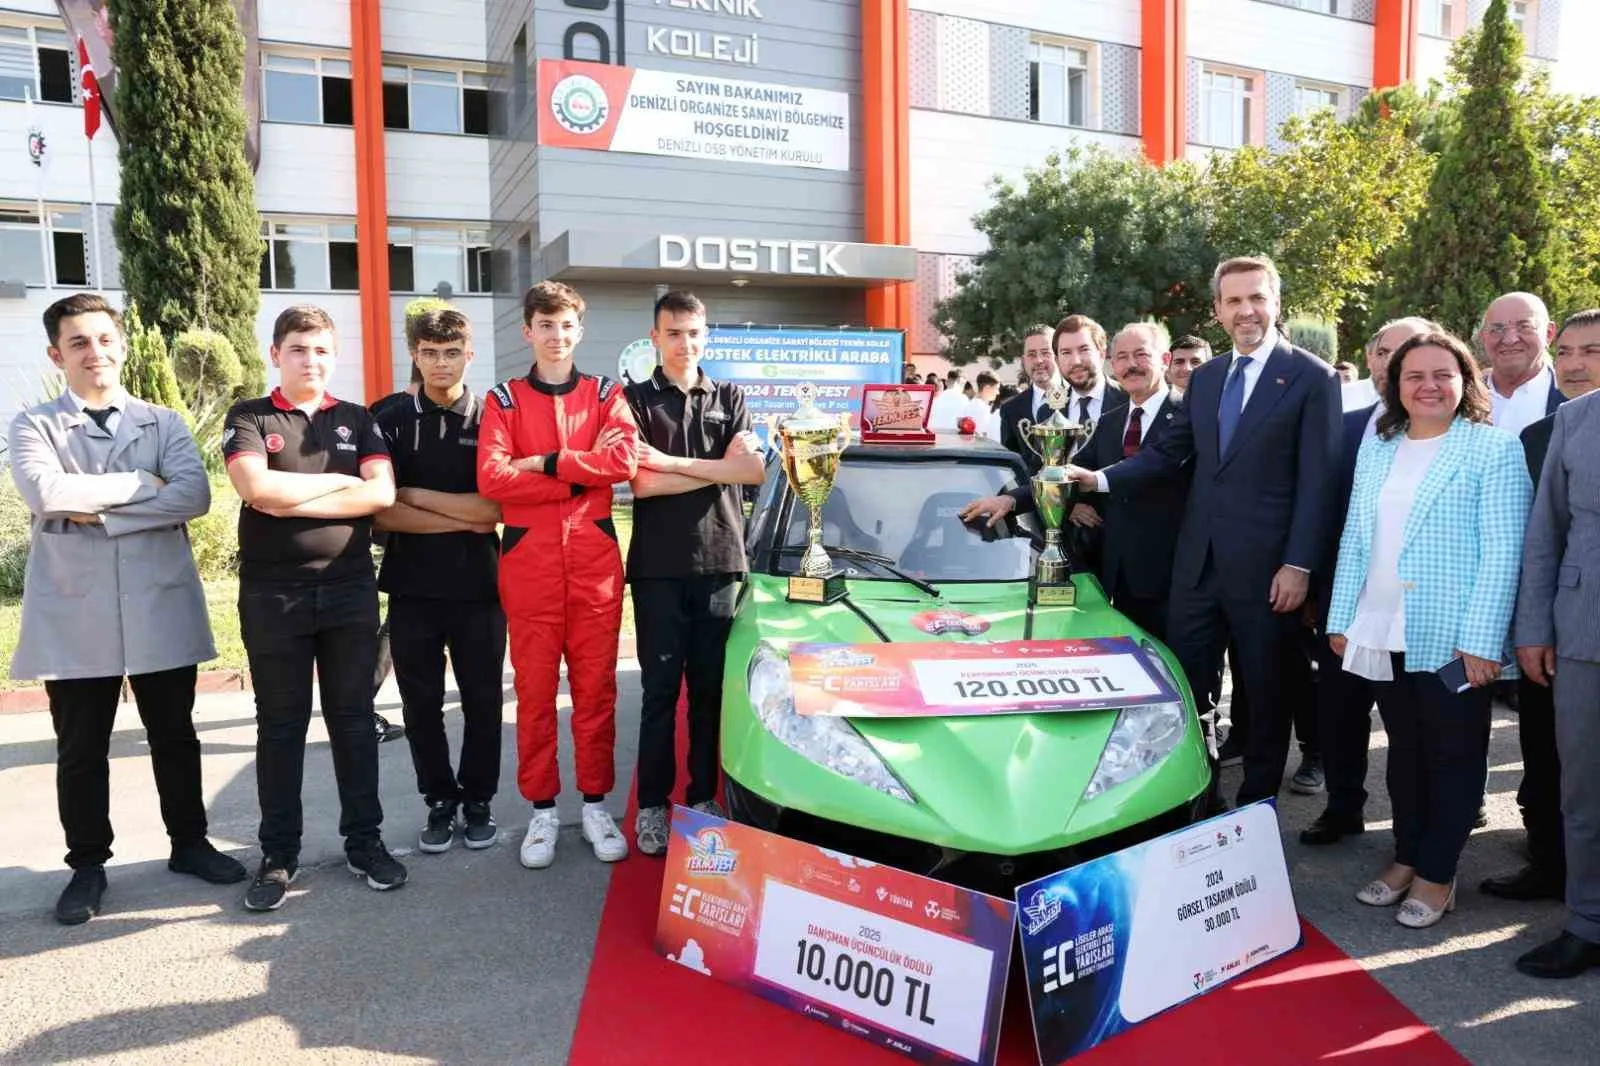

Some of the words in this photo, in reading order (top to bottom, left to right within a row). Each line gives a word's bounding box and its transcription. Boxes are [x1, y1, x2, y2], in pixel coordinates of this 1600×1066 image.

[647, 26, 759, 64] KOLEJİ
[676, 79, 720, 97] SAYIN
[724, 84, 803, 106] BAKANIMIZ
[630, 94, 677, 112] DENİZLİ
[679, 99, 739, 118] ORGANİZE
[741, 104, 782, 123] SANAYİ
[784, 108, 844, 130] BÖLGEMİZE
[694, 120, 790, 142] HOŞGELDİNİZ
[657, 136, 701, 153] DENİZLİ
[704, 141, 728, 155] OSB
[730, 143, 778, 161] YÖNETİM
[781, 149, 823, 164] KURULU
[658, 234, 849, 276] DOSTEK
[756, 346, 837, 363] ELEKTRİKLİ
[840, 350, 890, 364] ARABA
[954, 677, 1081, 698] 120.000
[1084, 675, 1124, 693] TL
[1205, 869, 1224, 888] 2024
[1177, 899, 1205, 921] GÖRSEL
[1204, 885, 1236, 911] TASARIM
[1234, 875, 1257, 897] ÖDÜLÜ
[858, 925, 881, 942] 2025
[1204, 910, 1232, 932] 30.000
[1230, 907, 1241, 921] TL
[807, 923, 850, 947] DANIŞMAN
[851, 937, 902, 965] ÜÇÜNCÜLÜK
[903, 955, 933, 976] ÖDÜLÜ
[1075, 940, 1115, 970] YARIŞLARI
[797, 939, 895, 1007] 10.000
[904, 976, 936, 1025] TL
